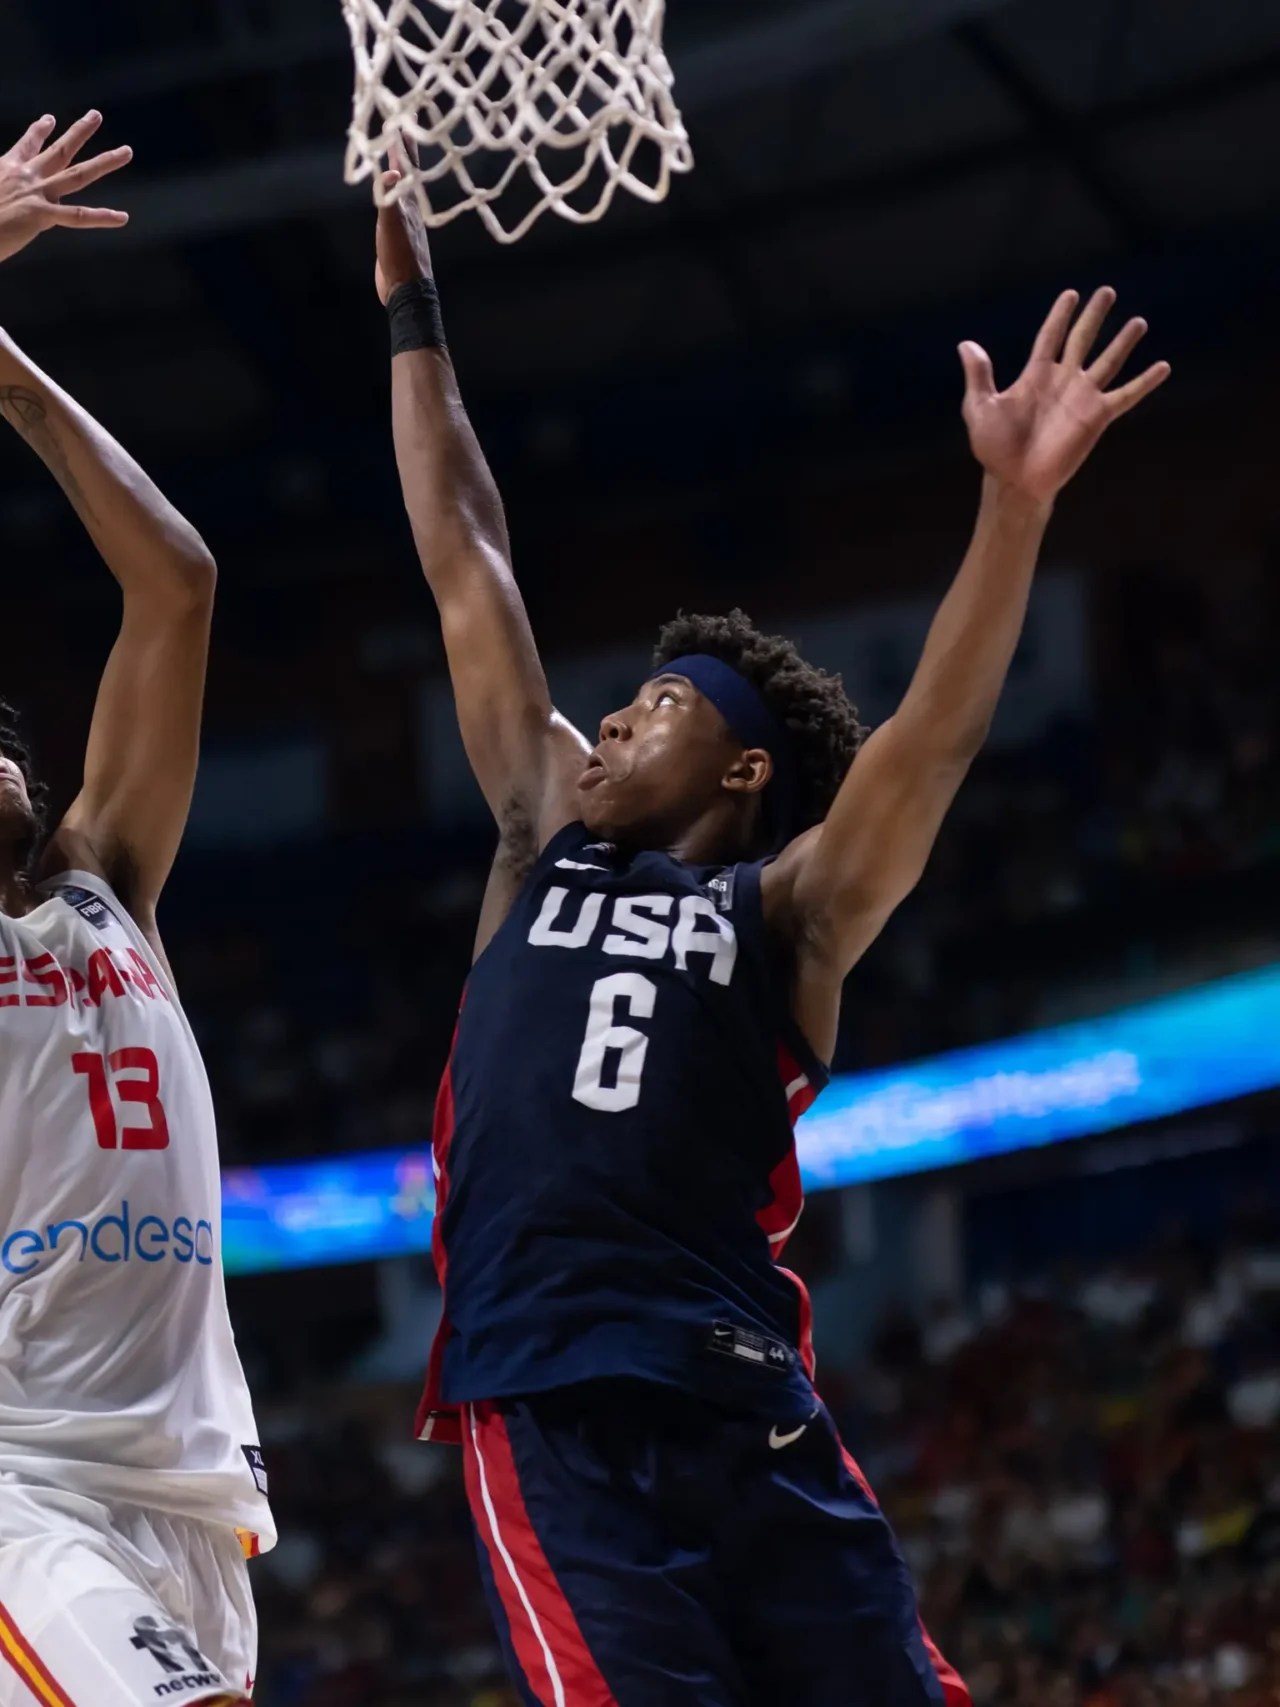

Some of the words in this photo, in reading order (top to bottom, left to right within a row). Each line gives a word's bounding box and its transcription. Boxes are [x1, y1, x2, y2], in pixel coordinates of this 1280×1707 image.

[80, 902, 106, 917] FIBA
[527, 886, 738, 986] USA
[572, 972, 657, 1112] 6
[72, 1047, 170, 1150] 13
[1, 1200, 213, 1275] endesa
